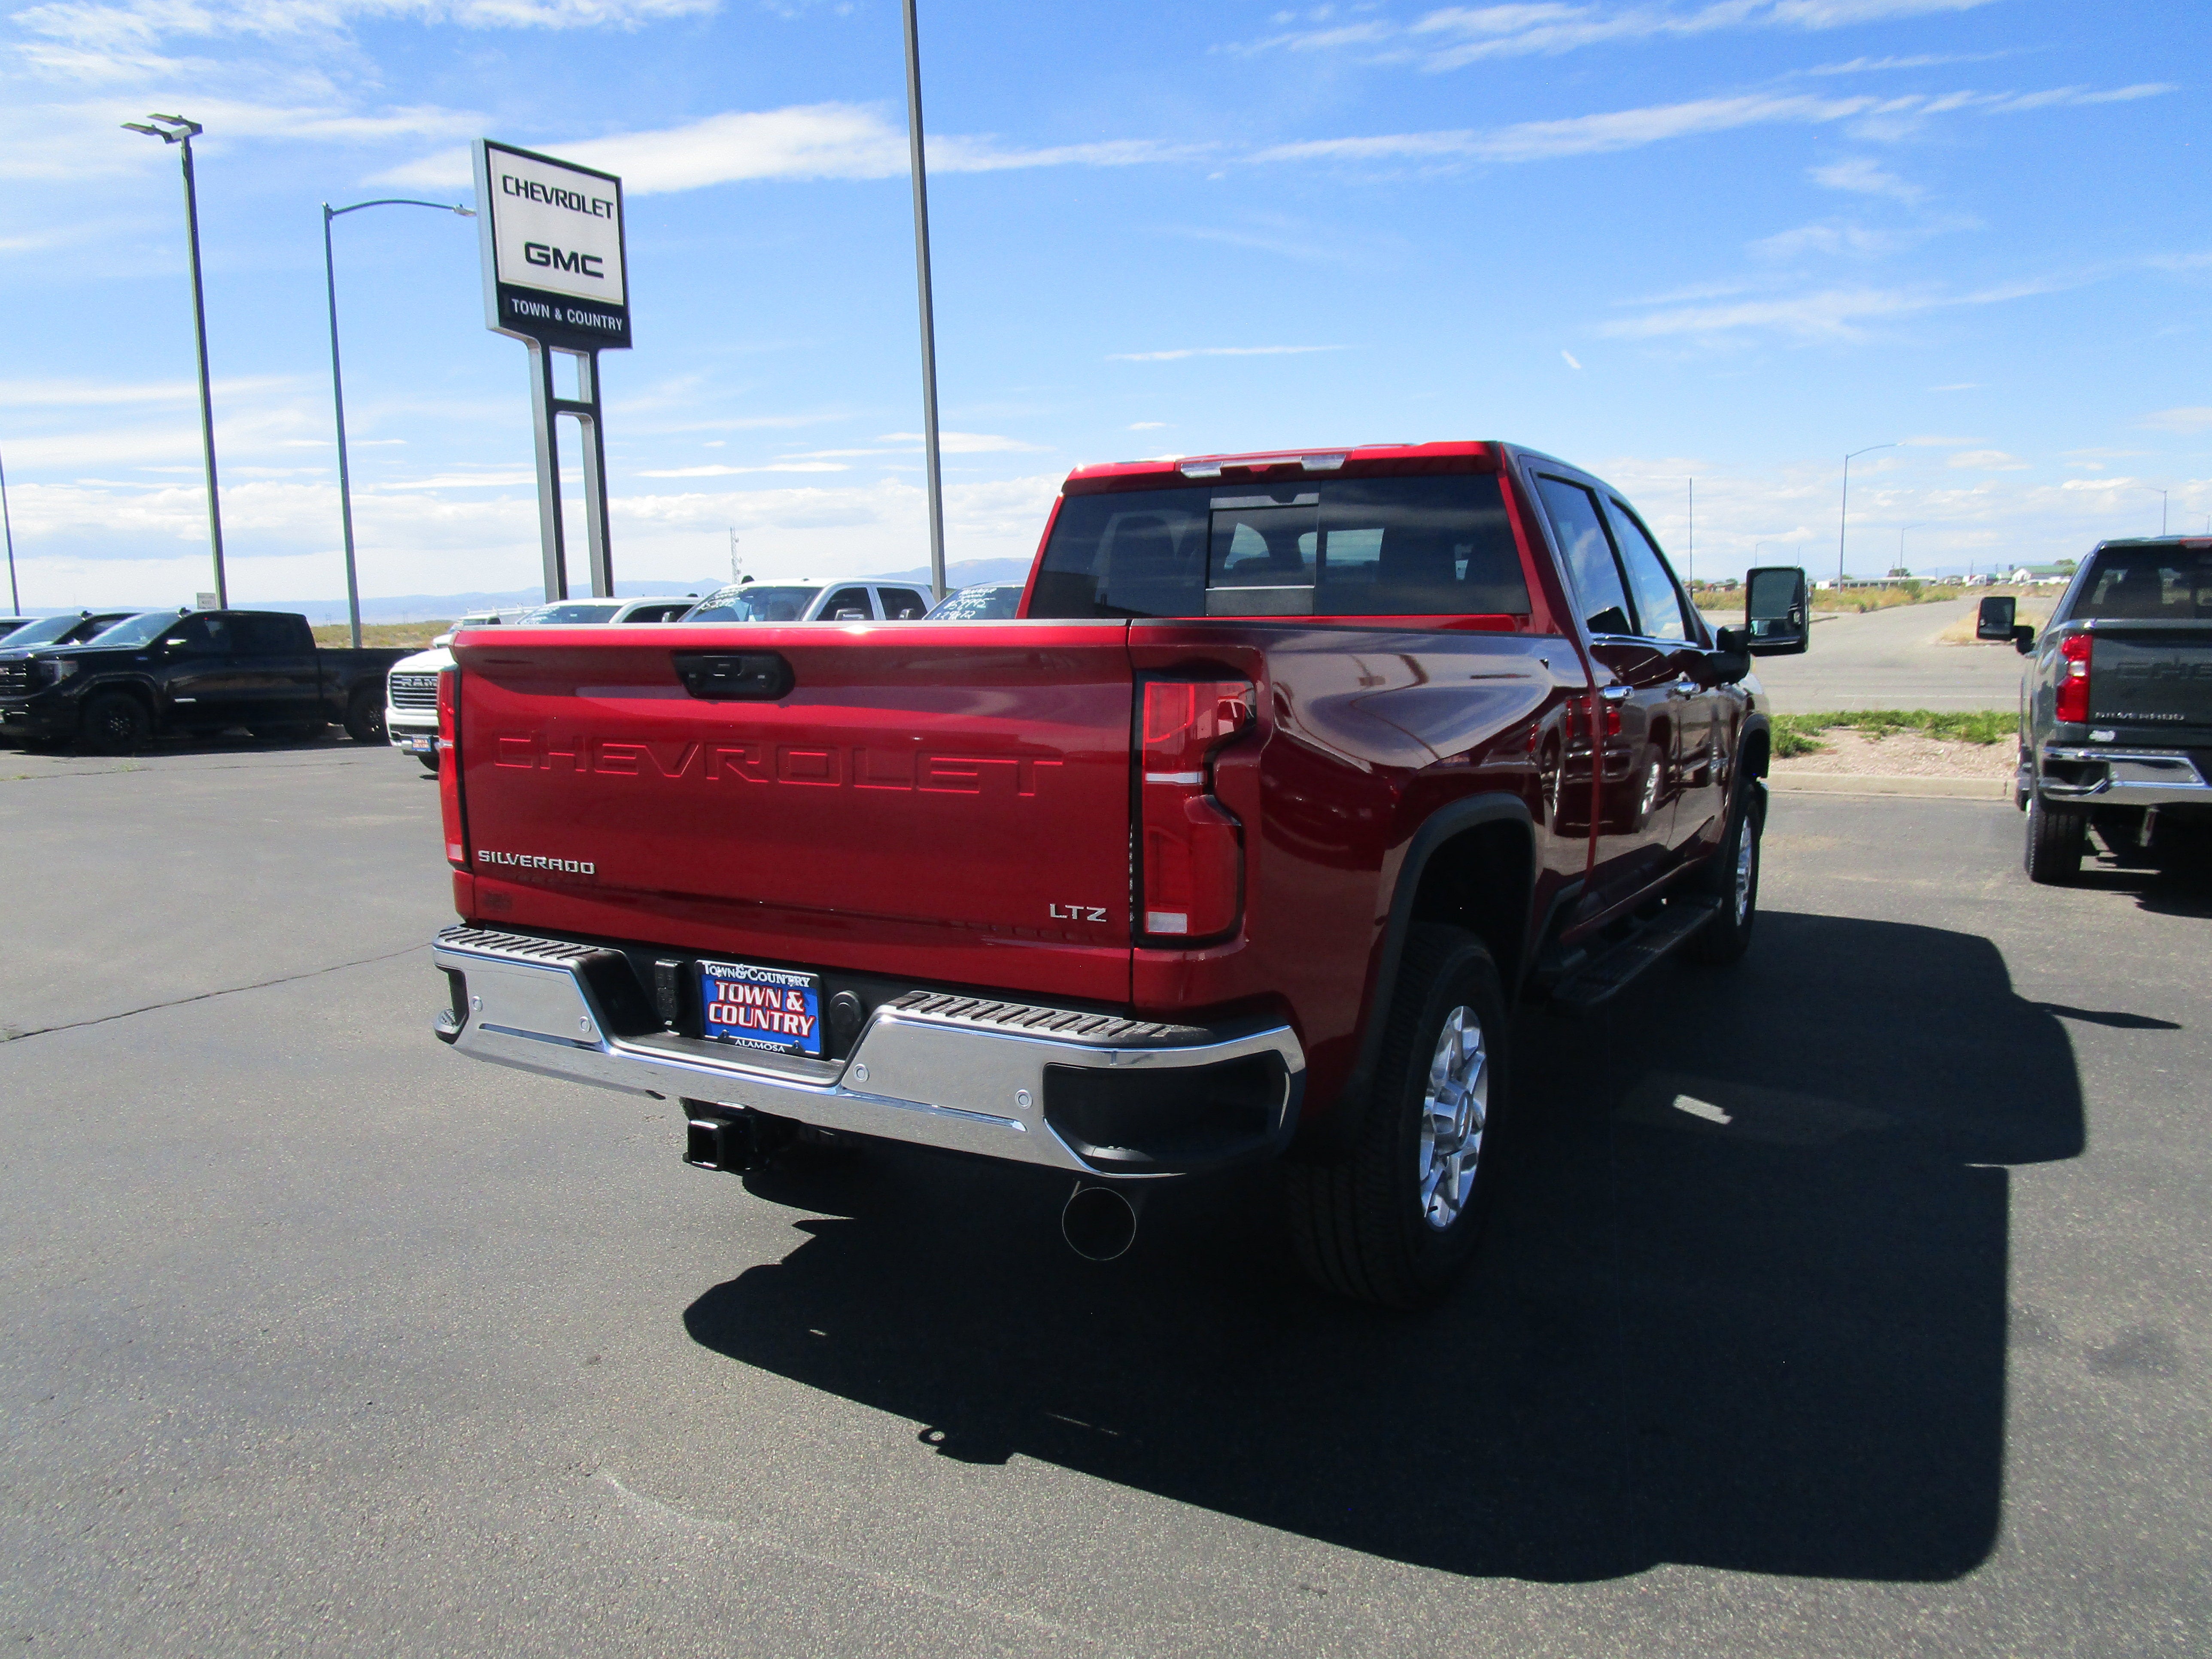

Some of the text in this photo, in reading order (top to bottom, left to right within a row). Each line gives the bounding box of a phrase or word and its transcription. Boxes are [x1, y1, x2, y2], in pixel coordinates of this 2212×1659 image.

[502, 174, 614, 219] CHEVROLET
[524, 241, 604, 278] GMC
[511, 299, 623, 331] TOWN & COUNTRY
[494, 732, 1063, 797] CHEVROLET
[478, 850, 595, 875] SILVERADO
[1050, 903, 1107, 922] LTZ
[715, 980, 805, 1012] TOWN &
[708, 1002, 816, 1038] COUNTRY
[735, 1039, 785, 1052] ALAMOSA
